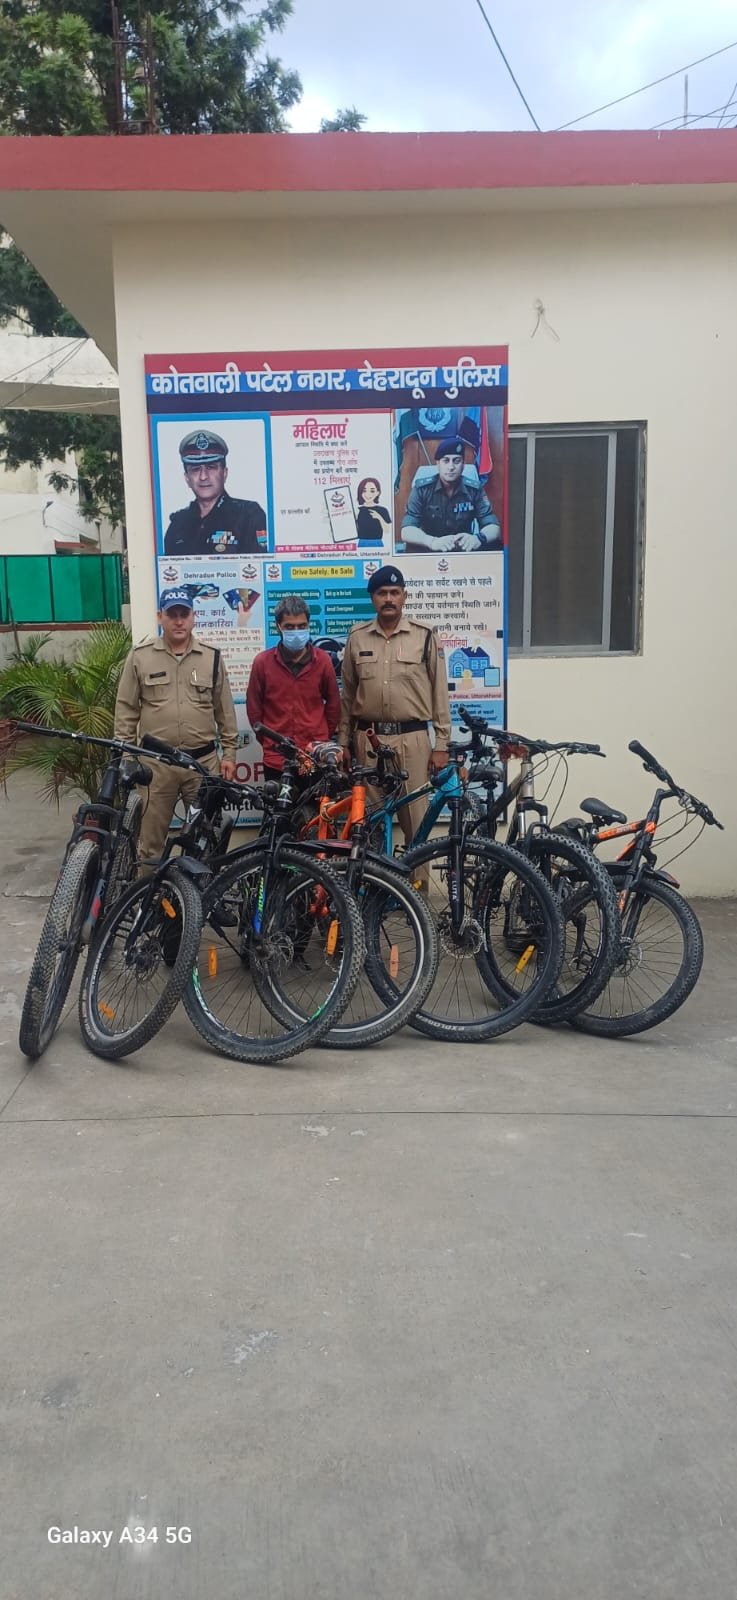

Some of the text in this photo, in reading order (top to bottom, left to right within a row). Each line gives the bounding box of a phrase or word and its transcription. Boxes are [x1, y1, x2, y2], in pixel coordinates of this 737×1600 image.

[150, 356, 502, 400] कोतवाली पटेल नगर, देहरादून पुलिस
[292, 418, 349, 440] महिलाएं
